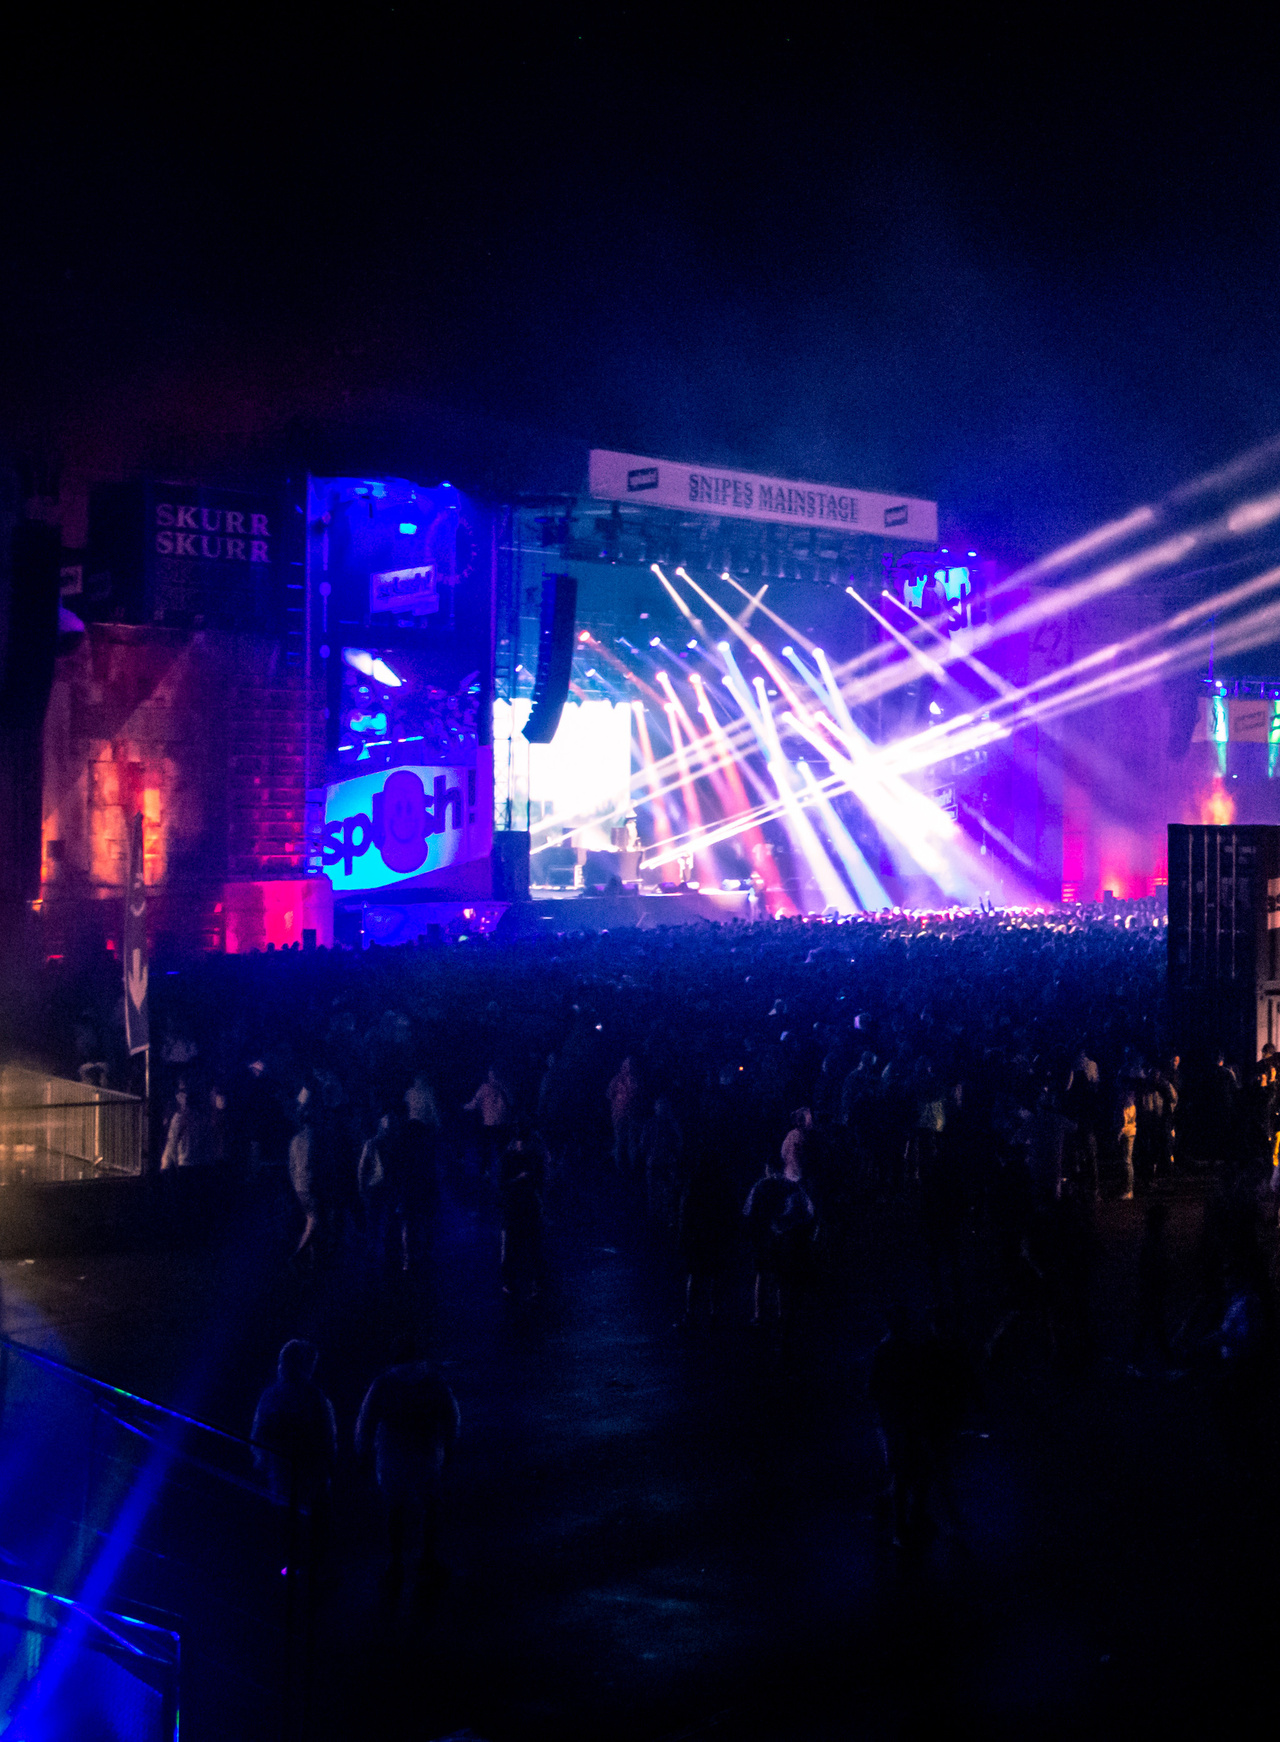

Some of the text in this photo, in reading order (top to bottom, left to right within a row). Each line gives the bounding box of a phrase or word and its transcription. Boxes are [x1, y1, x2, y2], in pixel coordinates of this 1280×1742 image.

[689, 473, 754, 497] SNIPES
[758, 483, 860, 512] MAINSTAGE
[155, 503, 271, 537] SKURR
[155, 530, 272, 563] SKURR
[321, 769, 477, 877] splsh!
